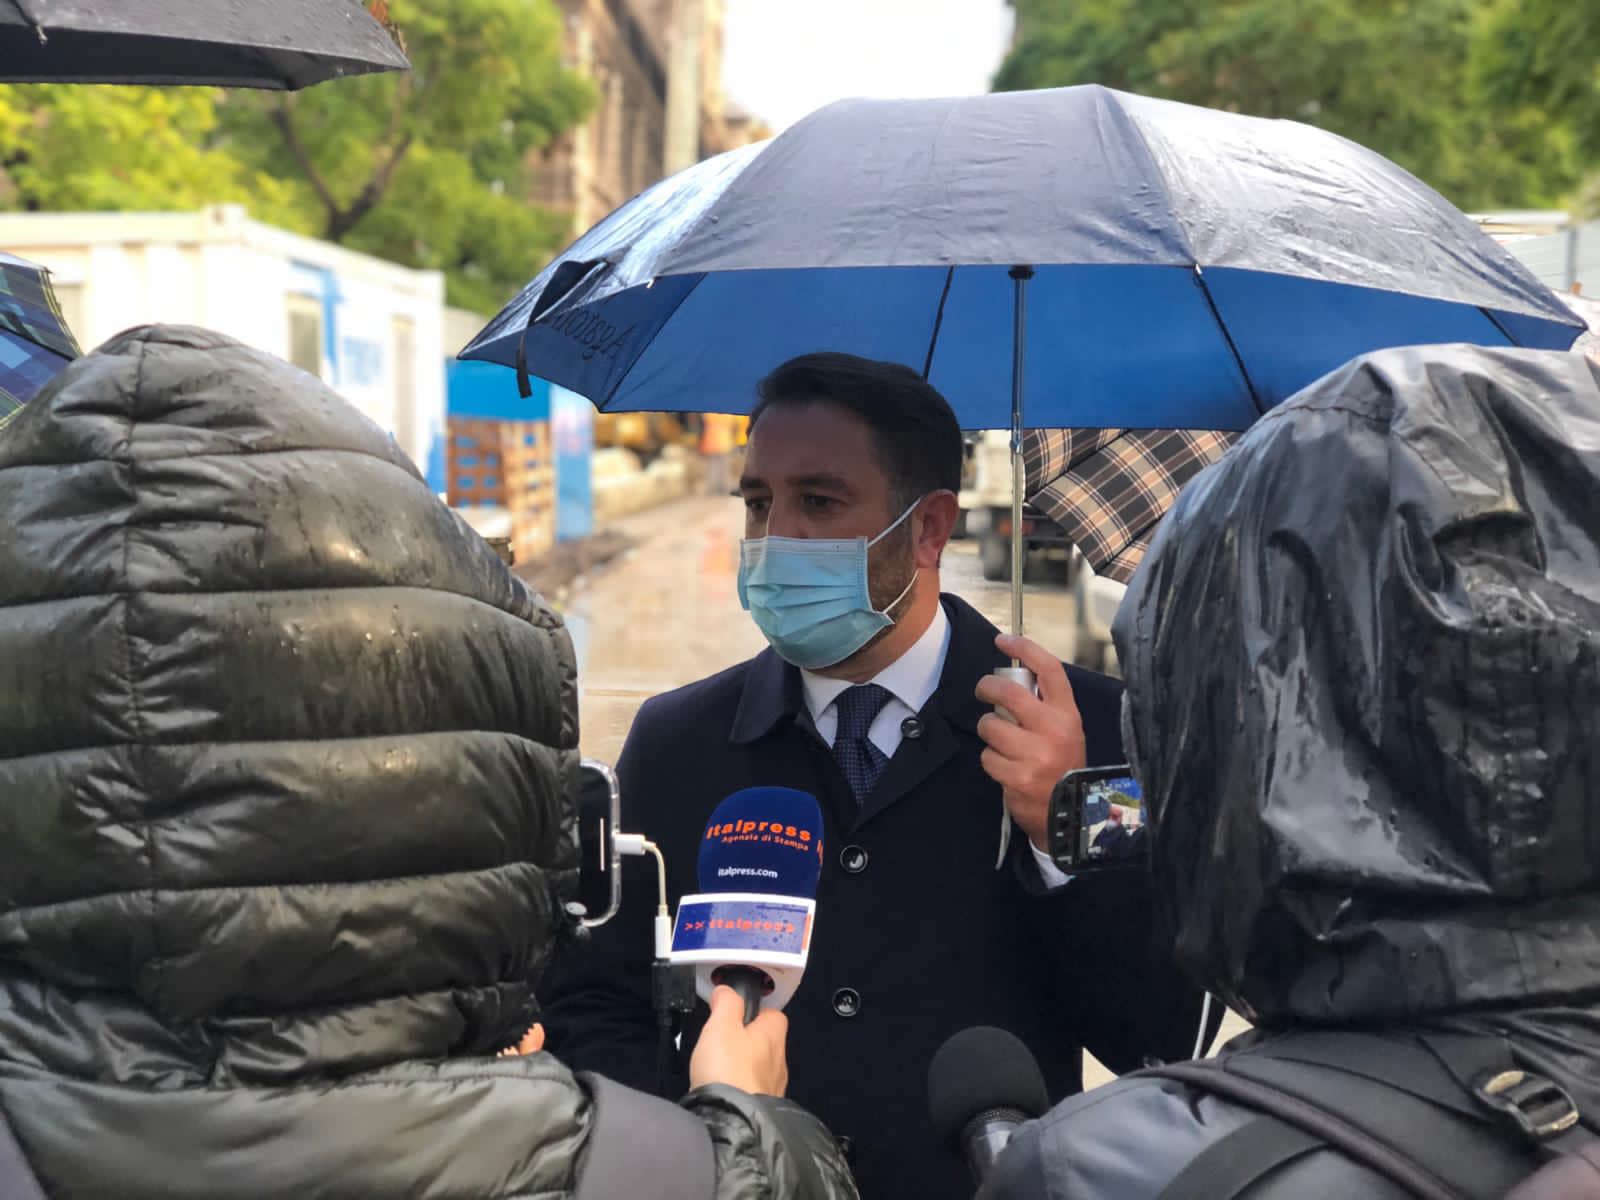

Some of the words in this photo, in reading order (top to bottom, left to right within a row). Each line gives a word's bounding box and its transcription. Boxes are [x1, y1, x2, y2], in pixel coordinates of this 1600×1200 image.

[721, 834, 759, 844] Agenzia
[761, 834, 772, 843] di
[774, 835, 809, 852] Stampa
